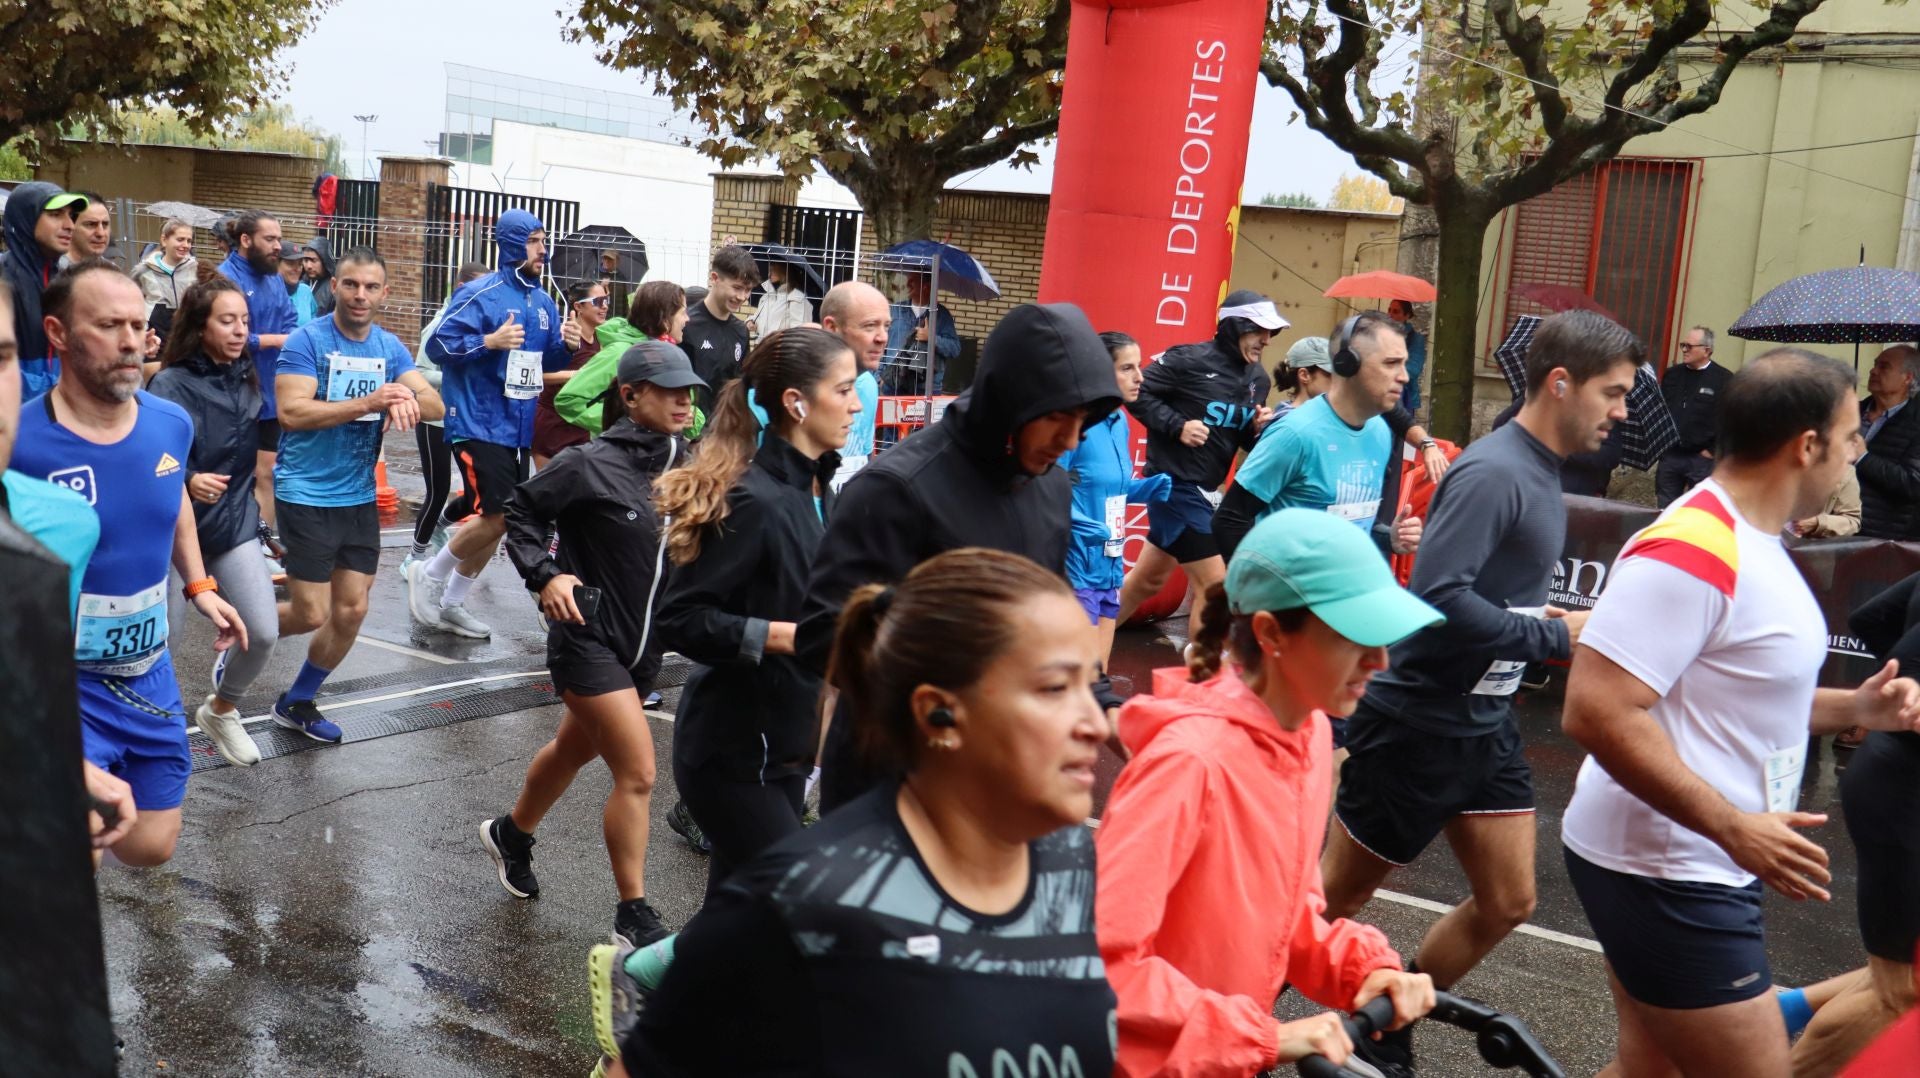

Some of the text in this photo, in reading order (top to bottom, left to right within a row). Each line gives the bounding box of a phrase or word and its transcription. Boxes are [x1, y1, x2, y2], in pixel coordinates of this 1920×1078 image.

[1155, 39, 1226, 327] DE DEPORTES
[102, 617, 155, 658] 330
